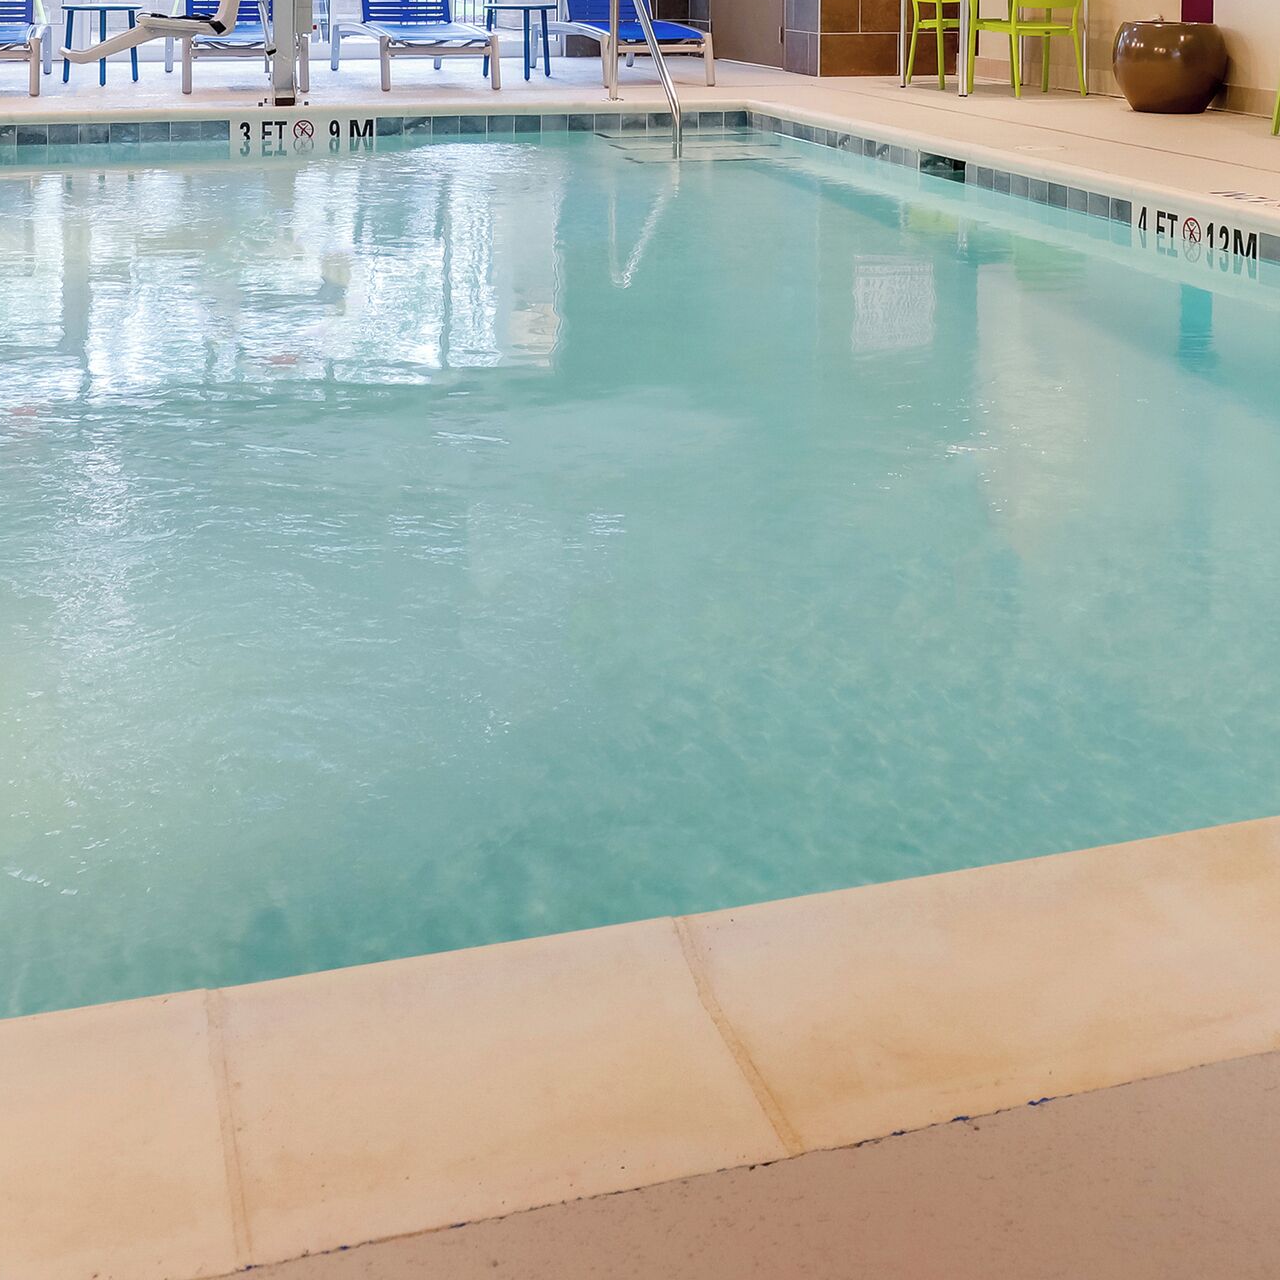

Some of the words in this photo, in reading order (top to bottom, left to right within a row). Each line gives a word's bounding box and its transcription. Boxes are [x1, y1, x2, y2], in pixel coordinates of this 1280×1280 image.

[239, 121, 251, 140] 3
[261, 120, 287, 140] FT
[349, 119, 374, 138] M
[1138, 206, 1147, 232] 4
[1156, 210, 1178, 239] FT
